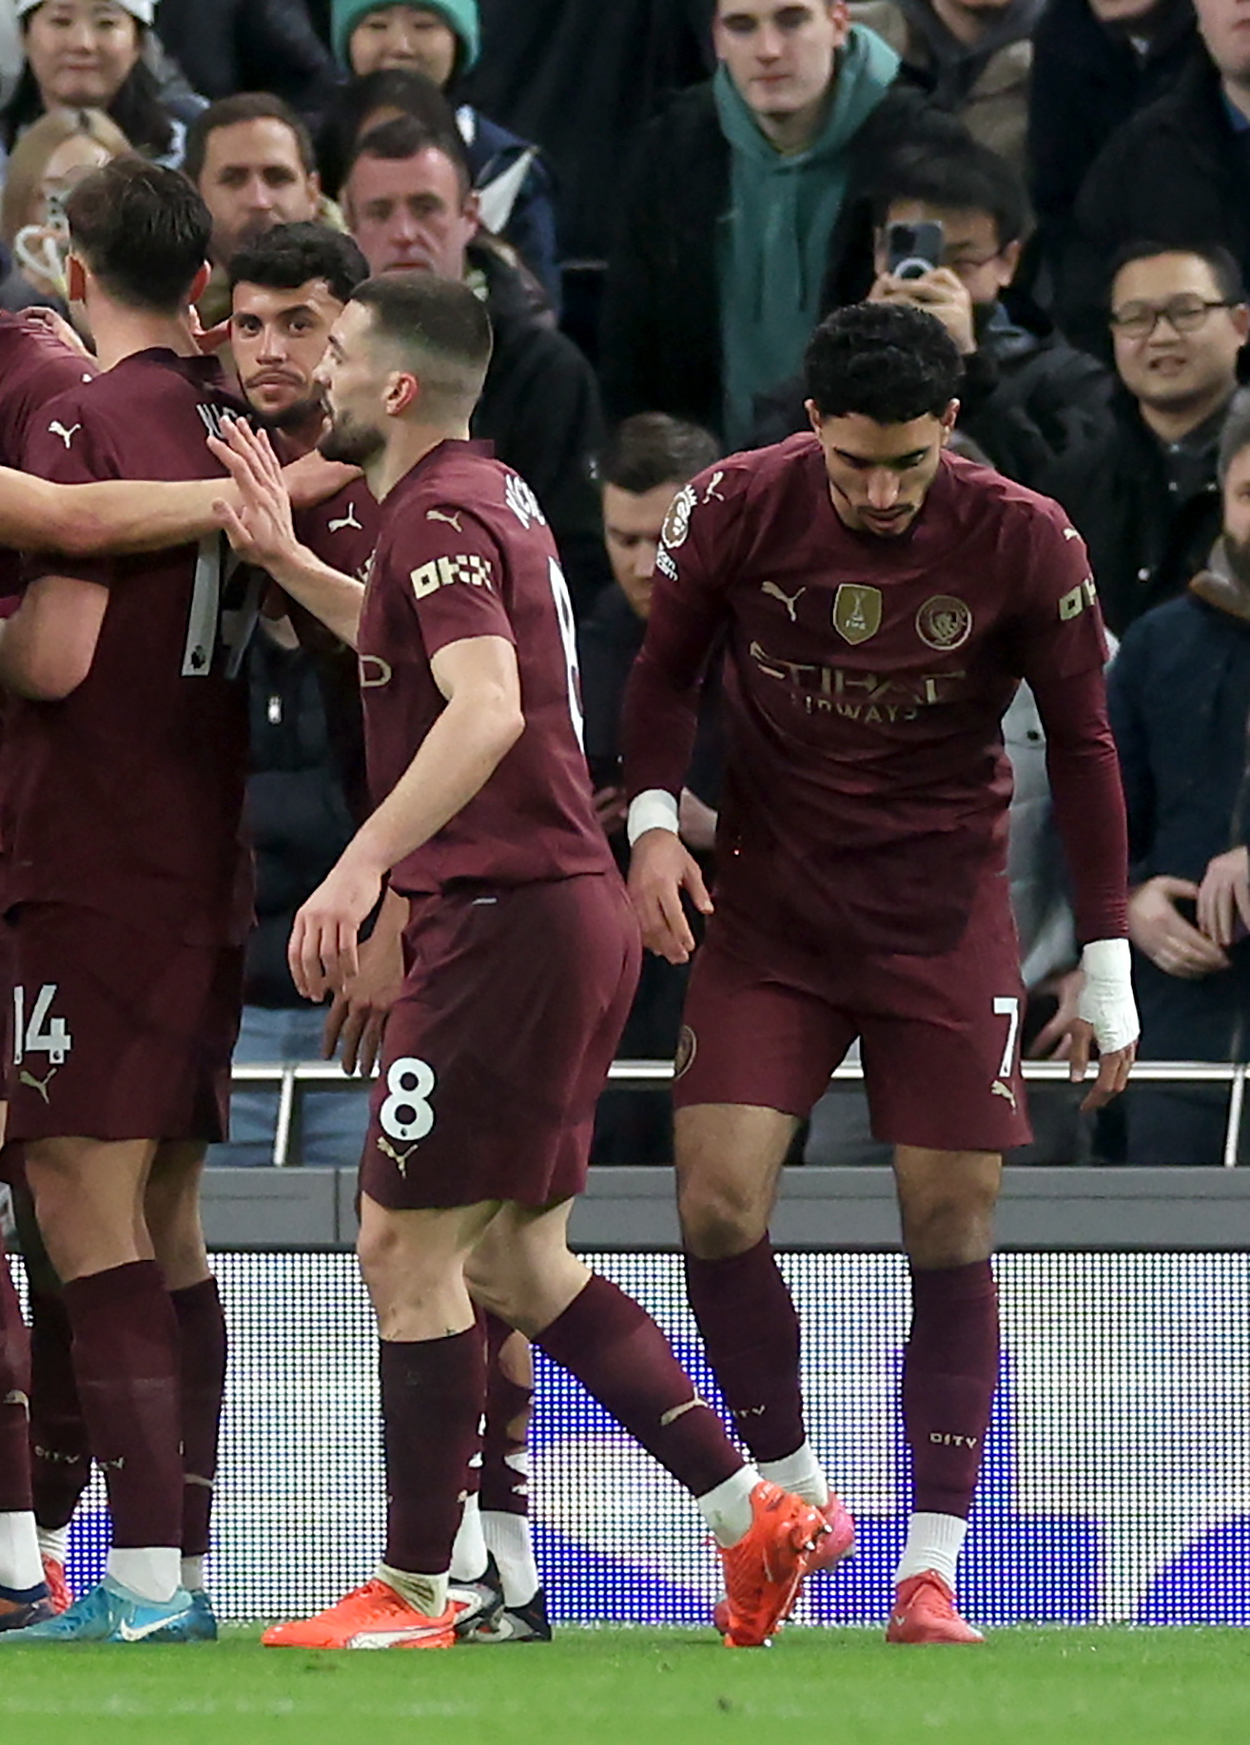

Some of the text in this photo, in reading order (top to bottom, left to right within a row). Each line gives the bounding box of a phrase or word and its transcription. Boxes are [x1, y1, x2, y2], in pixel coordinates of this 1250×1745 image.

[13, 984, 72, 1066] 14
[993, 997, 1018, 1078] 7
[380, 1056, 435, 1141] 8
